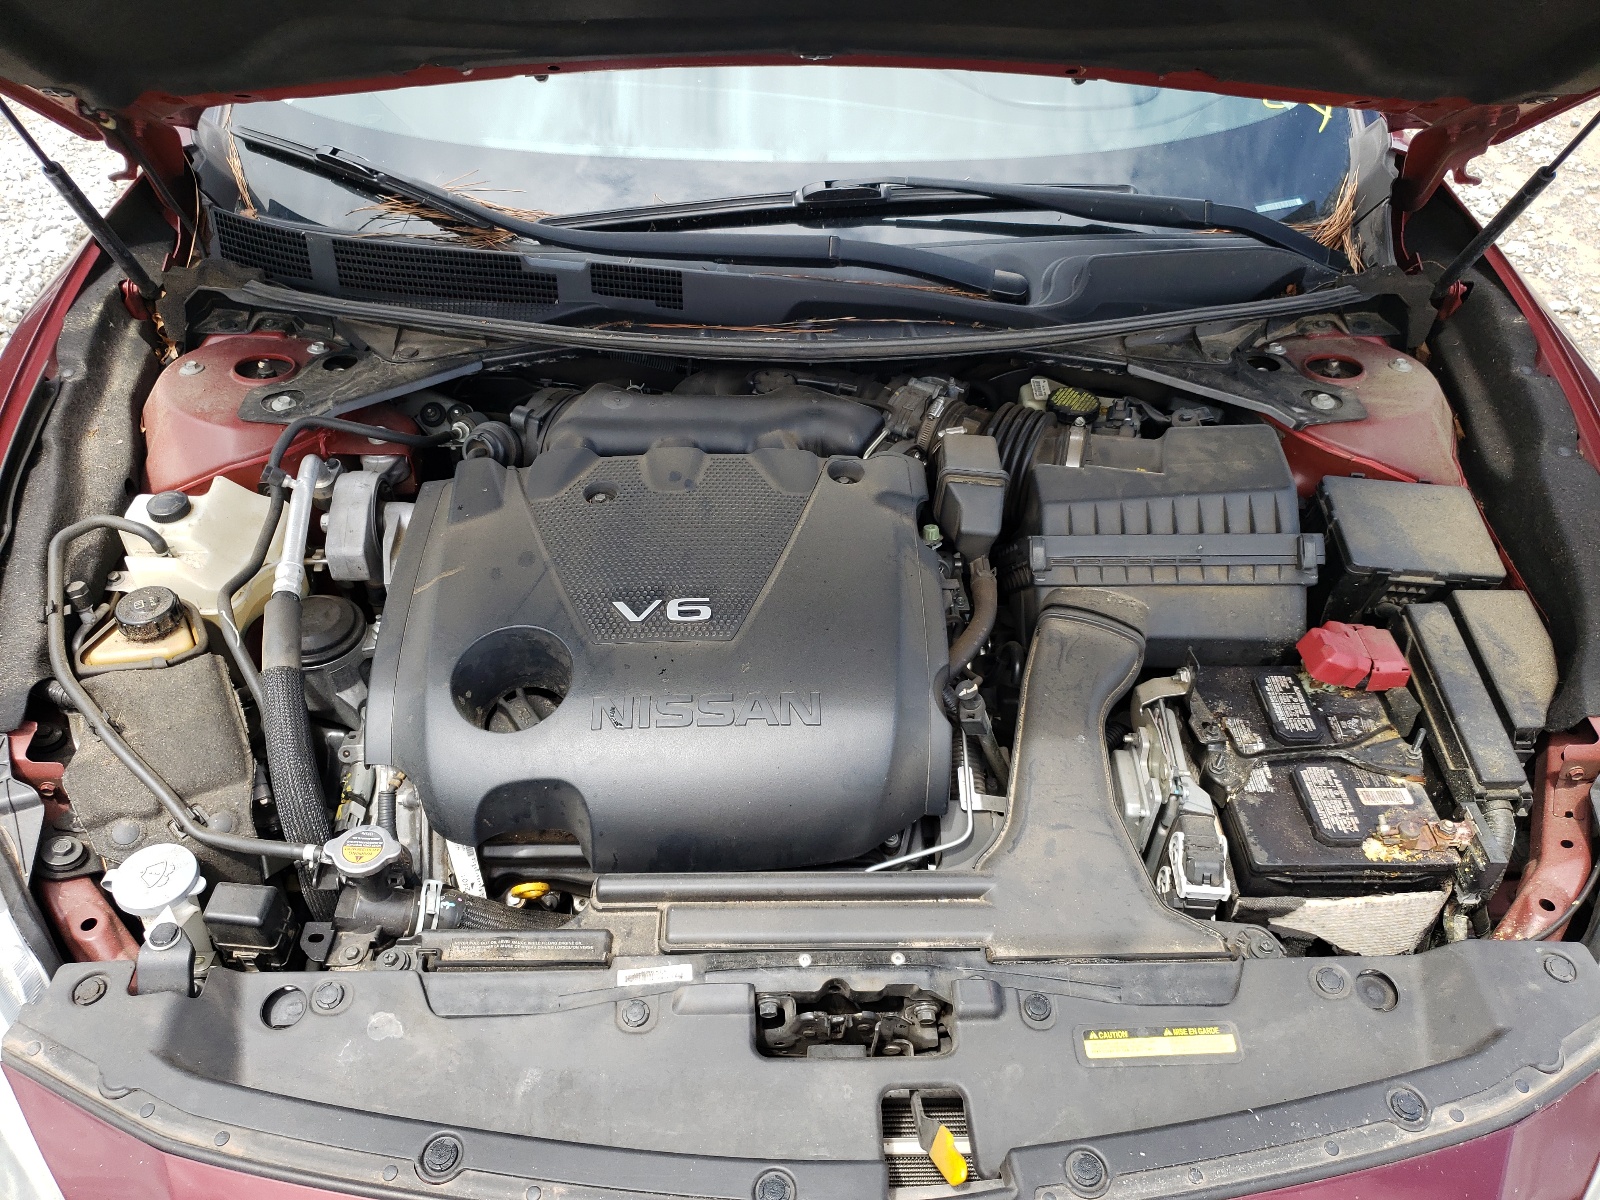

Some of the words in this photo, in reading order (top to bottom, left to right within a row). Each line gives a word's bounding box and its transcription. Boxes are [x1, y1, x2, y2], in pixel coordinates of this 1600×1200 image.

[611, 597, 712, 622] V6
[591, 691, 821, 731] NISSAN
[1098, 1030, 1129, 1039] CAUTION
[1172, 1027, 1188, 1036] MISE
[1188, 1027, 1197, 1035] EN
[1198, 1026, 1220, 1035] GARDE
